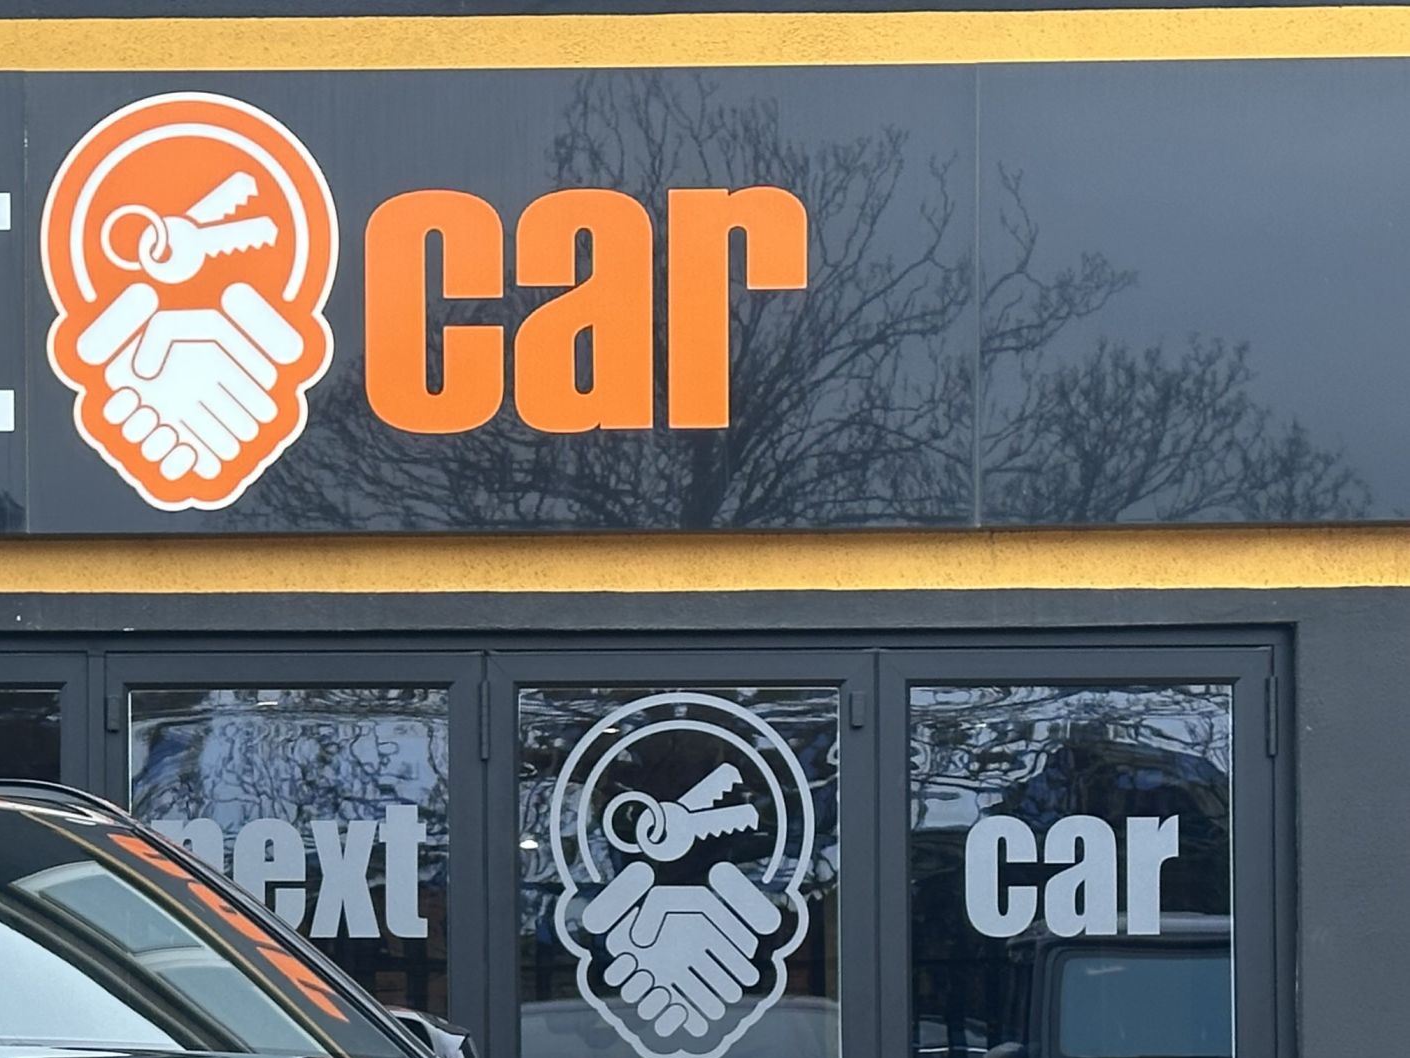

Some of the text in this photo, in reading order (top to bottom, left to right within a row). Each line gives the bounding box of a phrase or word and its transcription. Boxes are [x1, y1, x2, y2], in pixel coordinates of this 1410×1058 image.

[364, 186, 809, 435] car
[151, 803, 428, 939] ext
[965, 814, 1180, 938] car
